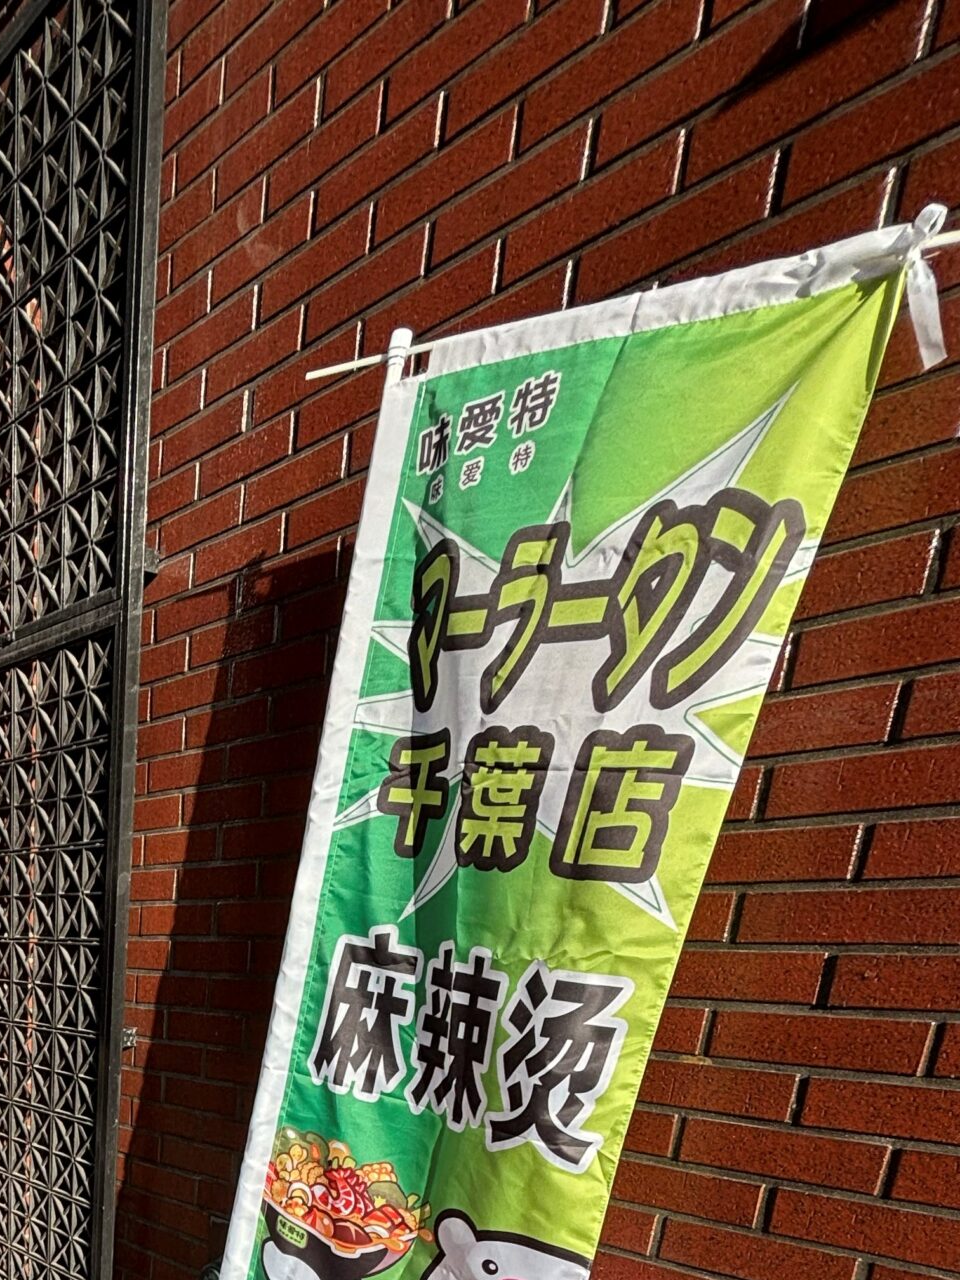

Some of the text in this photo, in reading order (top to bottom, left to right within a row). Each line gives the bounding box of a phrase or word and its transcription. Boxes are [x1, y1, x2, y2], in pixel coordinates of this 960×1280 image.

[408, 488, 806, 713] マーラータン
[377, 724, 695, 883] 千葉店
[311, 929, 629, 1170] 麻辣烫
